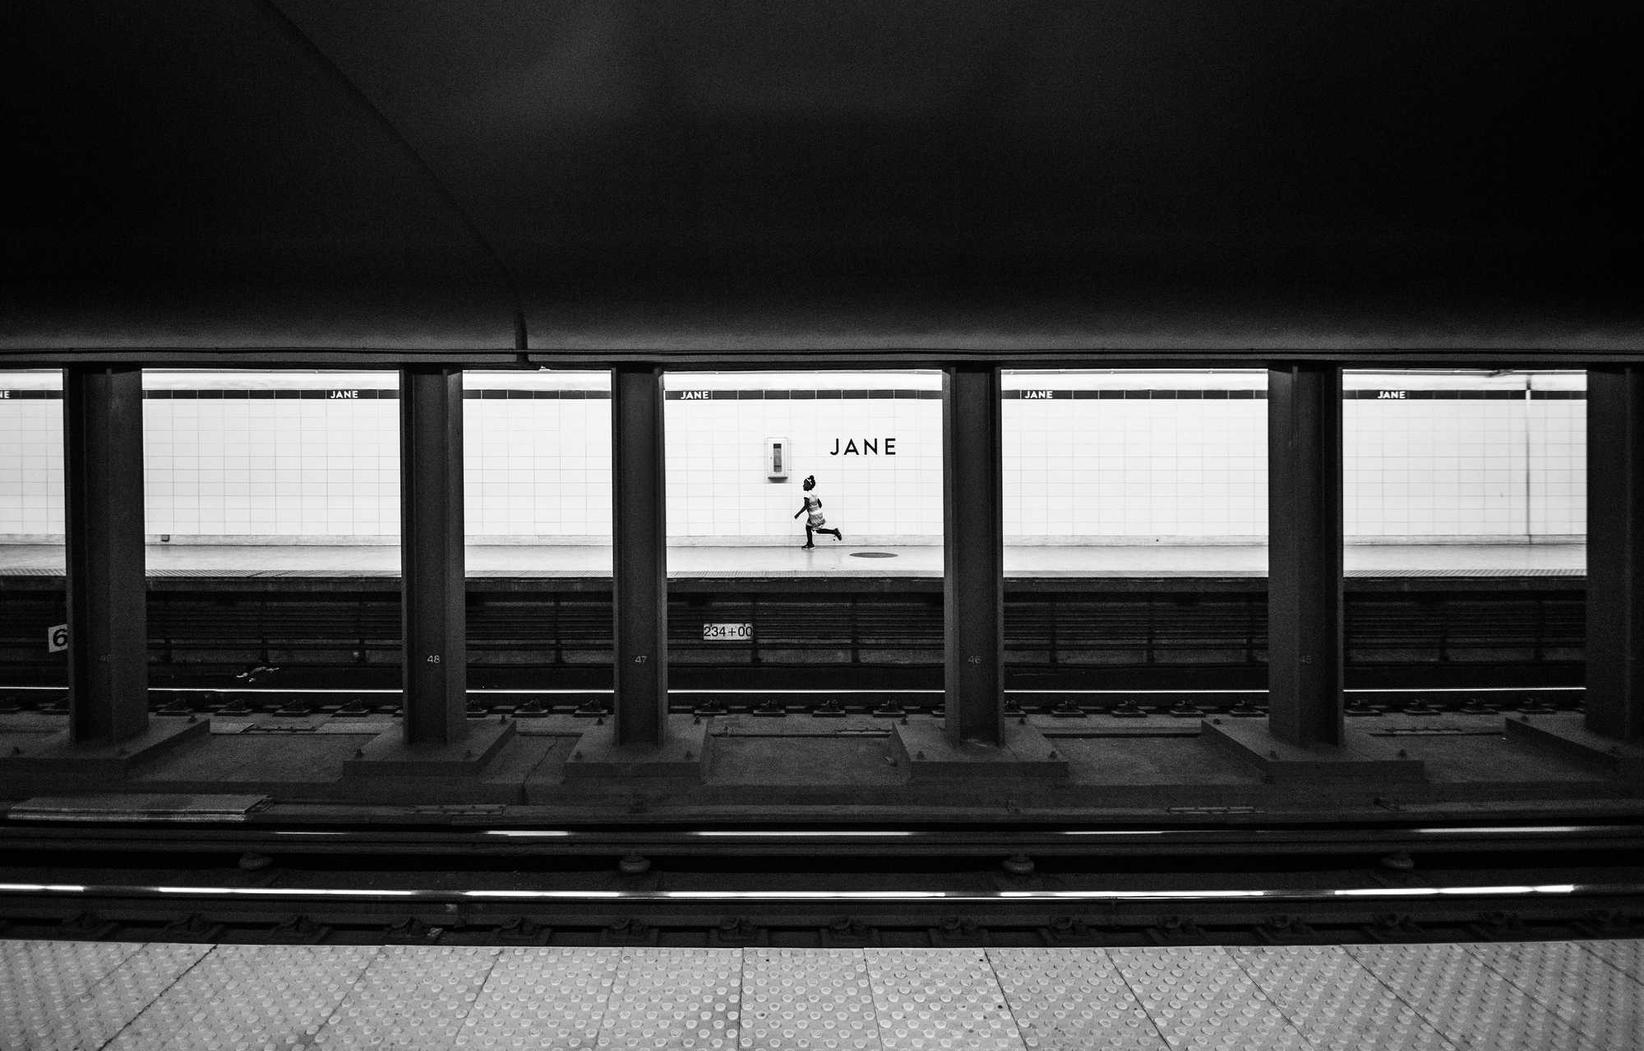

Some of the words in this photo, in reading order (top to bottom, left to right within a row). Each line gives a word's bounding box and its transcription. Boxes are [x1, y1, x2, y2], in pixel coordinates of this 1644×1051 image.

[330, 390, 359, 399] JANE
[680, 391, 709, 400] JANE
[1024, 390, 1053, 399] JANE
[1377, 391, 1406, 399] JANE
[830, 438, 896, 456] JANE
[704, 626, 753, 637] 234+00
[426, 655, 441, 664] 48
[633, 655, 648, 664] 47
